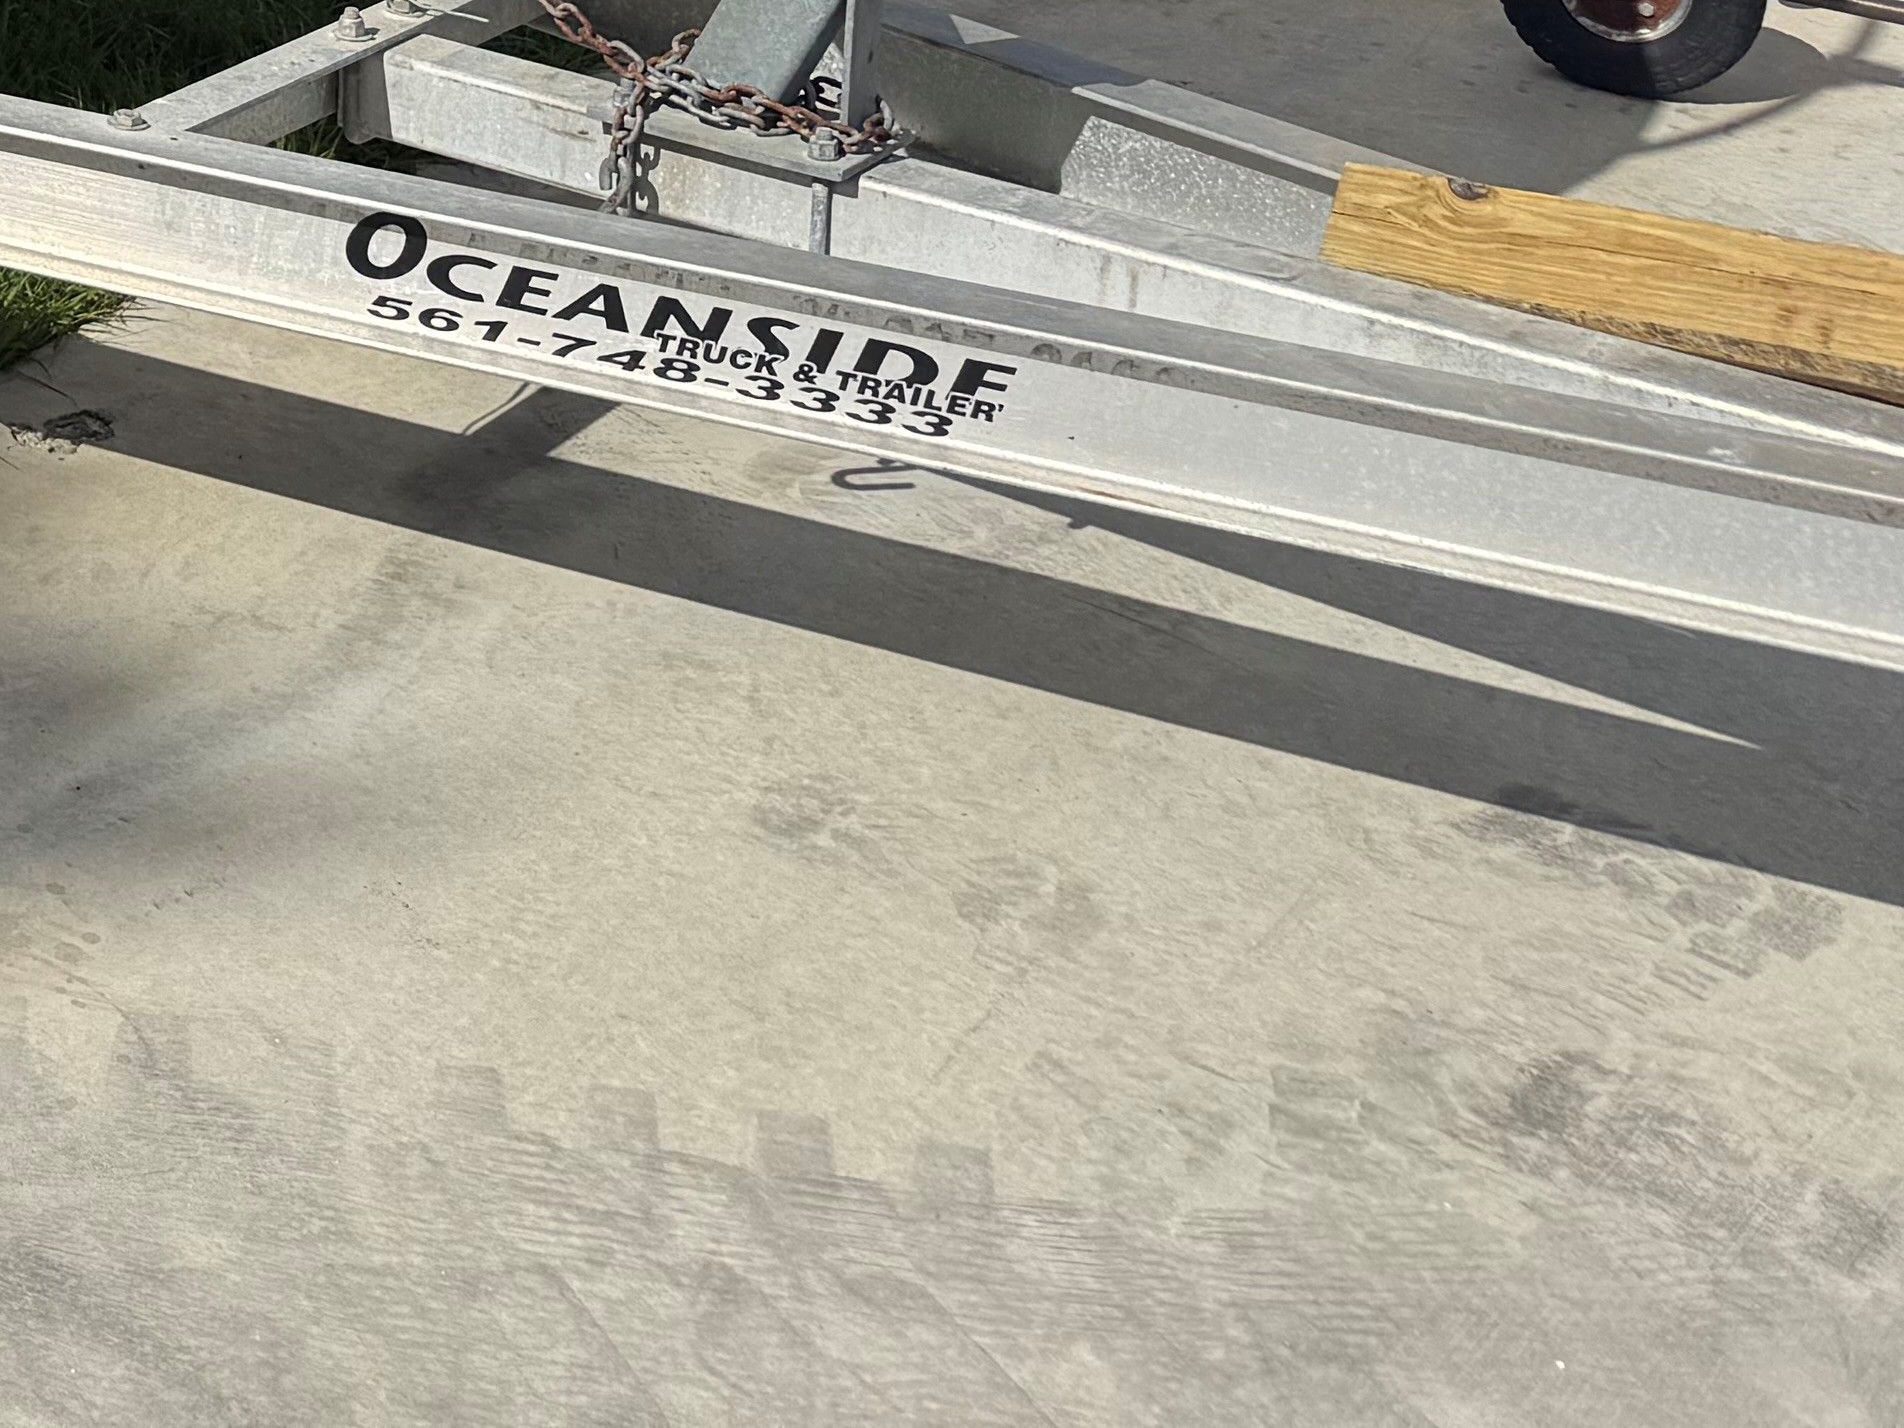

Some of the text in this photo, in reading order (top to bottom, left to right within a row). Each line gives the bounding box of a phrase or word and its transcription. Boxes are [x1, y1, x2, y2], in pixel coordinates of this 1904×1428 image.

[366, 295, 955, 438] 561-748-3333
[655, 331, 998, 423] TRUCK & TRAILER
